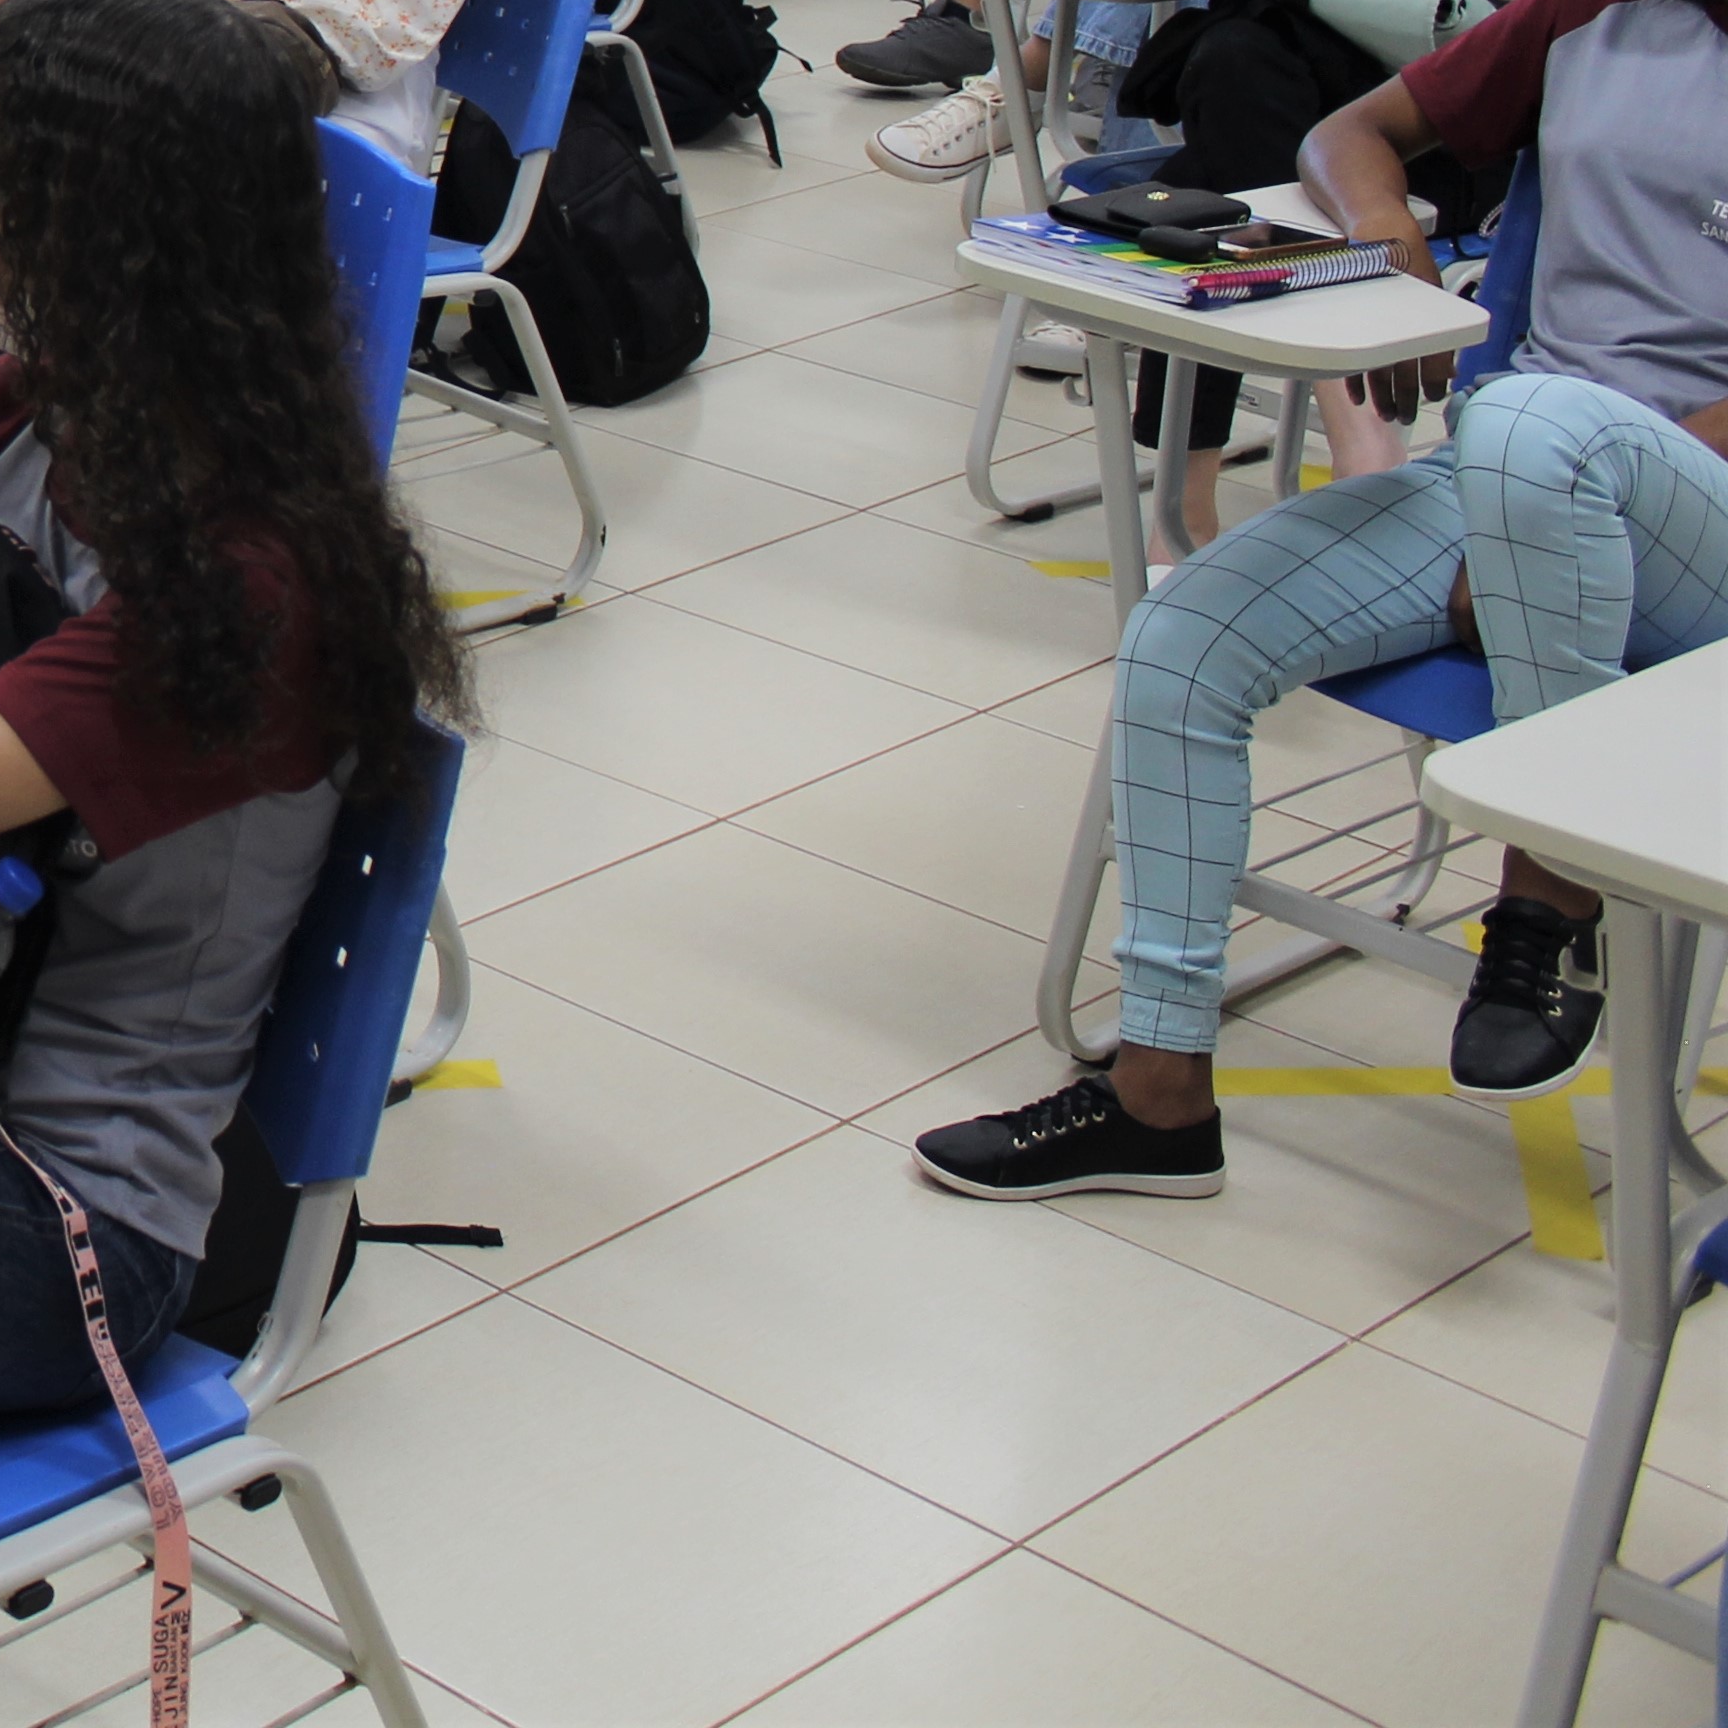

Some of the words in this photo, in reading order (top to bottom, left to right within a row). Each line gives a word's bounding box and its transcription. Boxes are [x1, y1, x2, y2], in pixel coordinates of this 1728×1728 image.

[160, 1580, 187, 1610] V
[153, 1615, 169, 1674] SUGA
[164, 1675, 179, 1719] JIN
